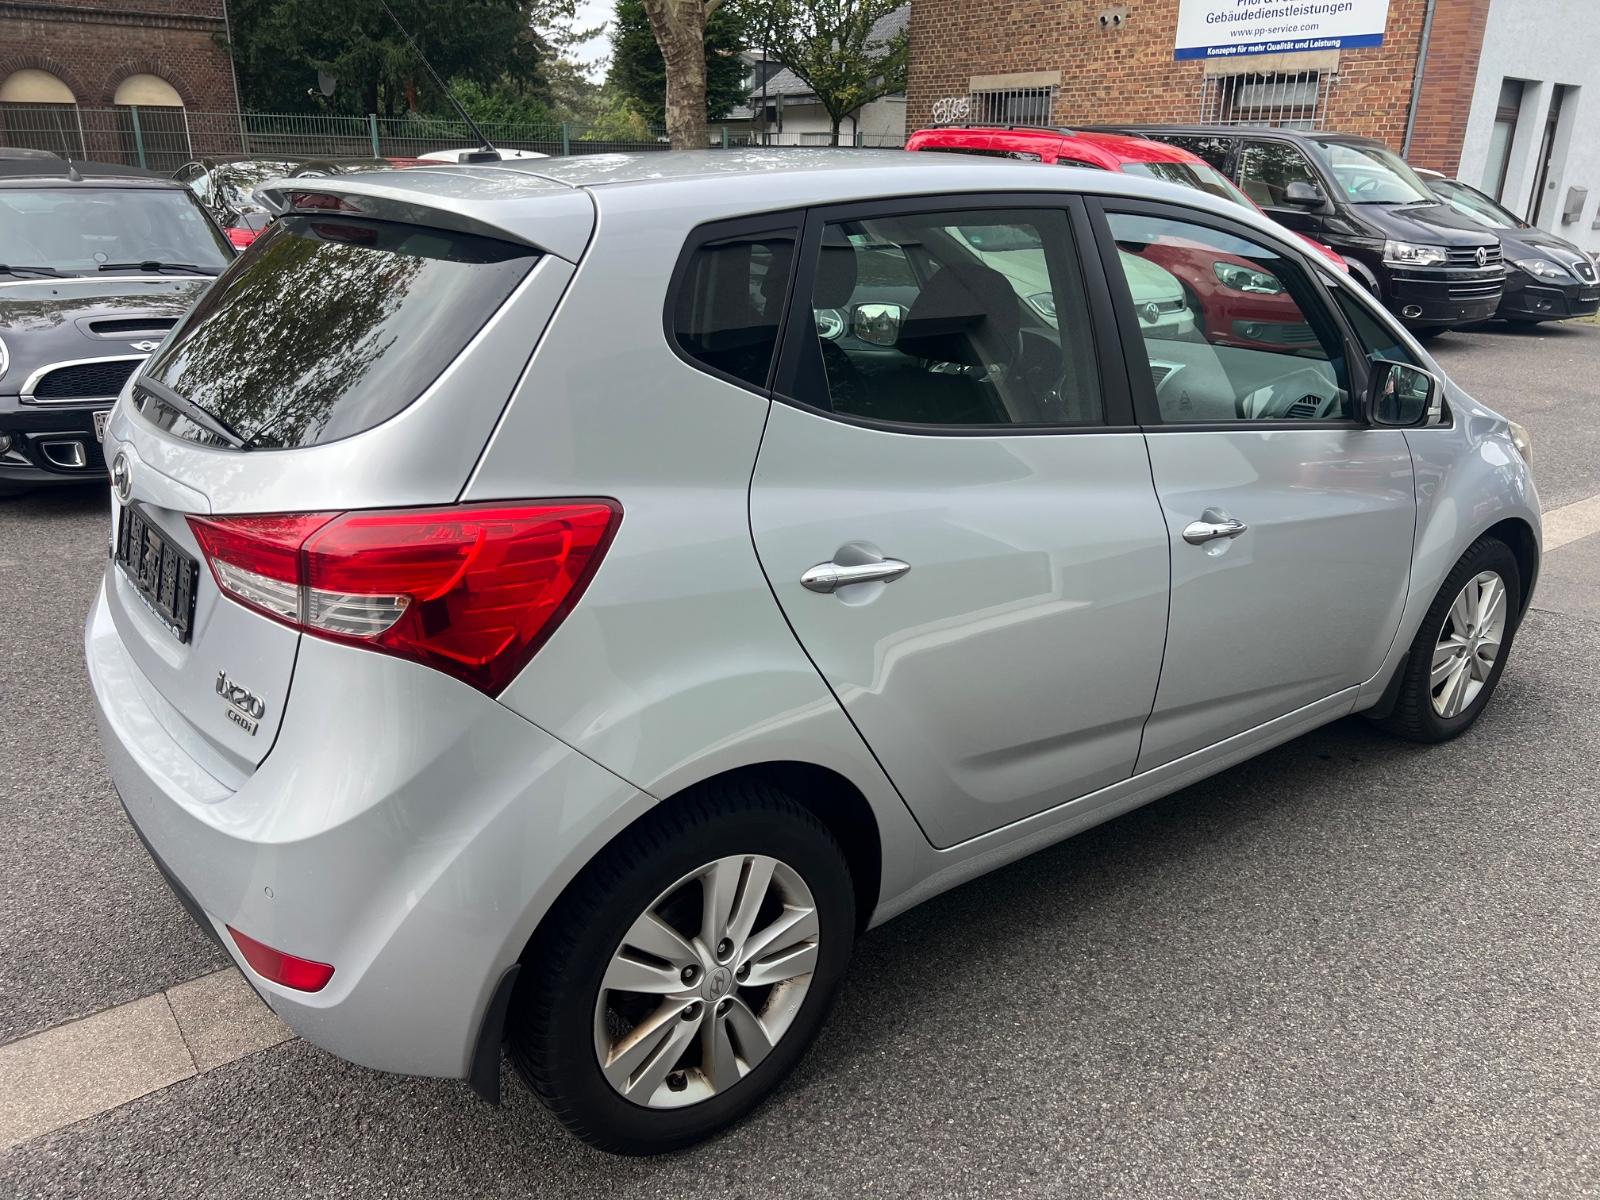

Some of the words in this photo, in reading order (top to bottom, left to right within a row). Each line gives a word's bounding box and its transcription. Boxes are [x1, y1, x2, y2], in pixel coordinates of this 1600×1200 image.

[1206, 2, 1353, 24] Gebäudedienstleistungen
[1230, 23, 1319, 37] www.pp-service.com
[1207, 47, 1236, 55] Konzepte
[1237, 45, 1247, 53] für
[1248, 44, 1266, 52] mehr
[1266, 42, 1294, 51] Qualität
[1295, 40, 1309, 49] und
[1310, 39, 1341, 48] Leistung
[216, 669, 266, 720] ix20
[227, 709, 252, 732] CRDi
